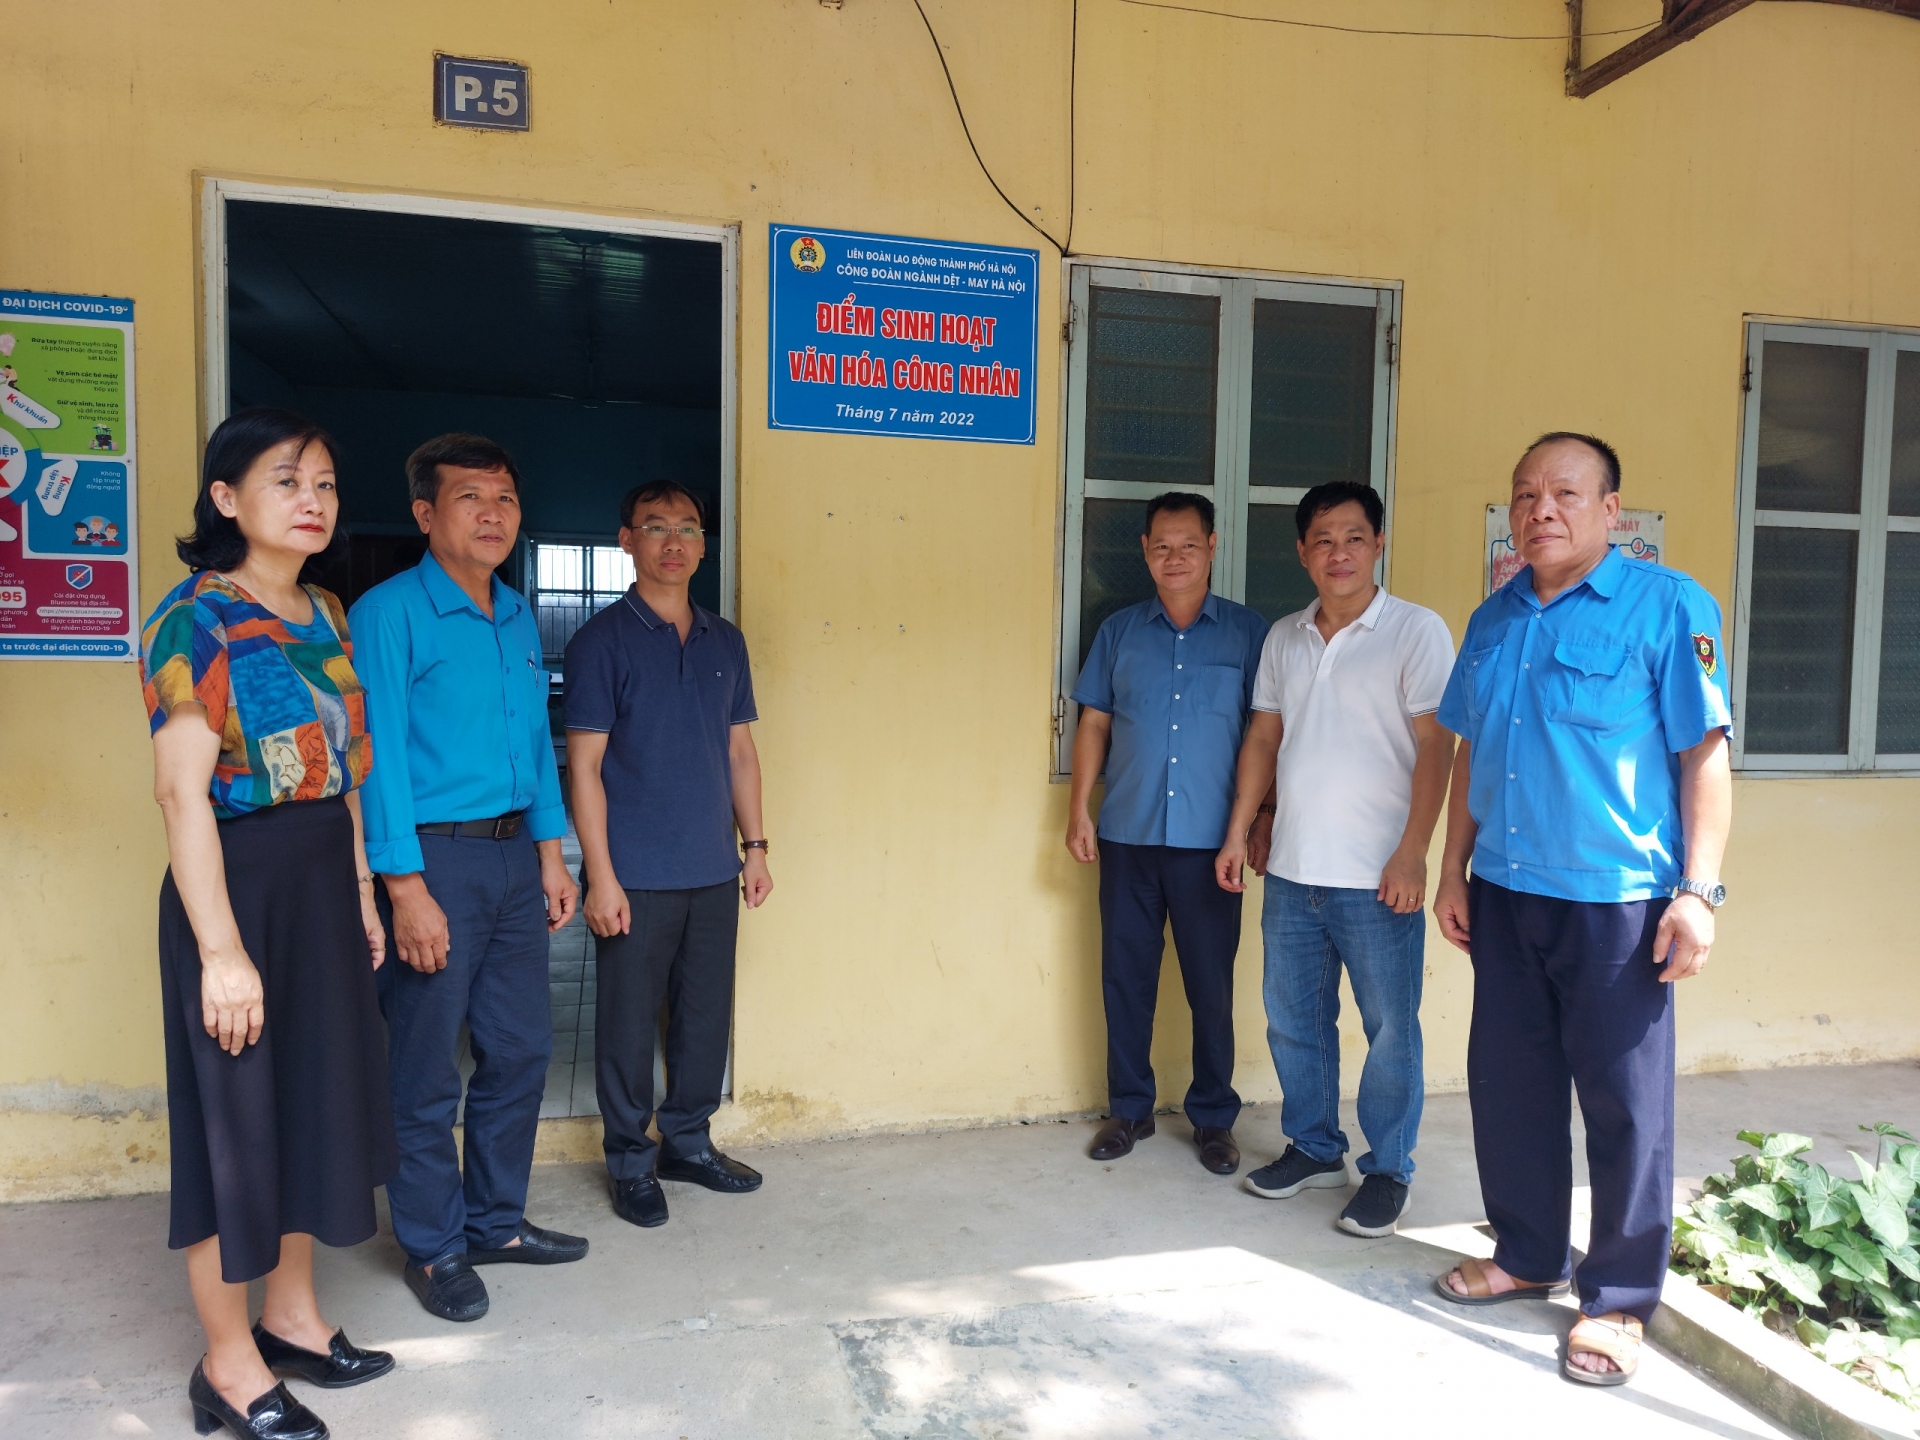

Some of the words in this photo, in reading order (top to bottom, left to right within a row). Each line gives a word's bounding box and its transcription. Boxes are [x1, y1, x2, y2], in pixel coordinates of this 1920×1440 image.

[454, 75, 519, 117] P.5
[847, 247, 864, 260] LIÊN
[866, 250, 891, 263] ĐOÀN
[893, 254, 910, 265] LAO
[912, 254, 937, 268] ĐỘNG
[939, 257, 967, 270] THÀNH
[968, 259, 986, 272] PHỐ
[988, 262, 1000, 273] HÀ
[1001, 263, 1017, 276] NỘI
[836, 262, 869, 278] CÔNG
[871, 267, 902, 281] ĐOÀN
[904, 270, 941, 284] NGÀNH
[943, 273, 960, 289] DỆT
[968, 277, 989, 289] MAY
[991, 278, 1006, 291] HÀ
[1008, 279, 1026, 295] NỘI
[2, 297, 26, 310] ĐẠI
[28, 299, 61, 311] DỊCH
[63, 301, 124, 315] COVID-19
[816, 292, 875, 337] ĐIỂM
[880, 308, 935, 342] SINH
[940, 313, 997, 352] HOẠT
[788, 345, 836, 385] VĂN
[841, 350, 887, 388] HÓA
[893, 354, 954, 394] CÔNG
[959, 360, 1021, 398] NHÂN
[835, 403, 884, 423] Tháng
[889, 407, 898, 421] 7
[901, 408, 935, 424] năm
[939, 411, 975, 426] 2022
[41, 481, 55, 500] trung
[1633, 540, 1642, 551] 4
[0, 591, 23, 602] 95
[13, 642, 41, 651] trước
[42, 643, 58, 652] đại
[59, 643, 80, 652] dịch
[80, 644, 124, 652] COVID-19
